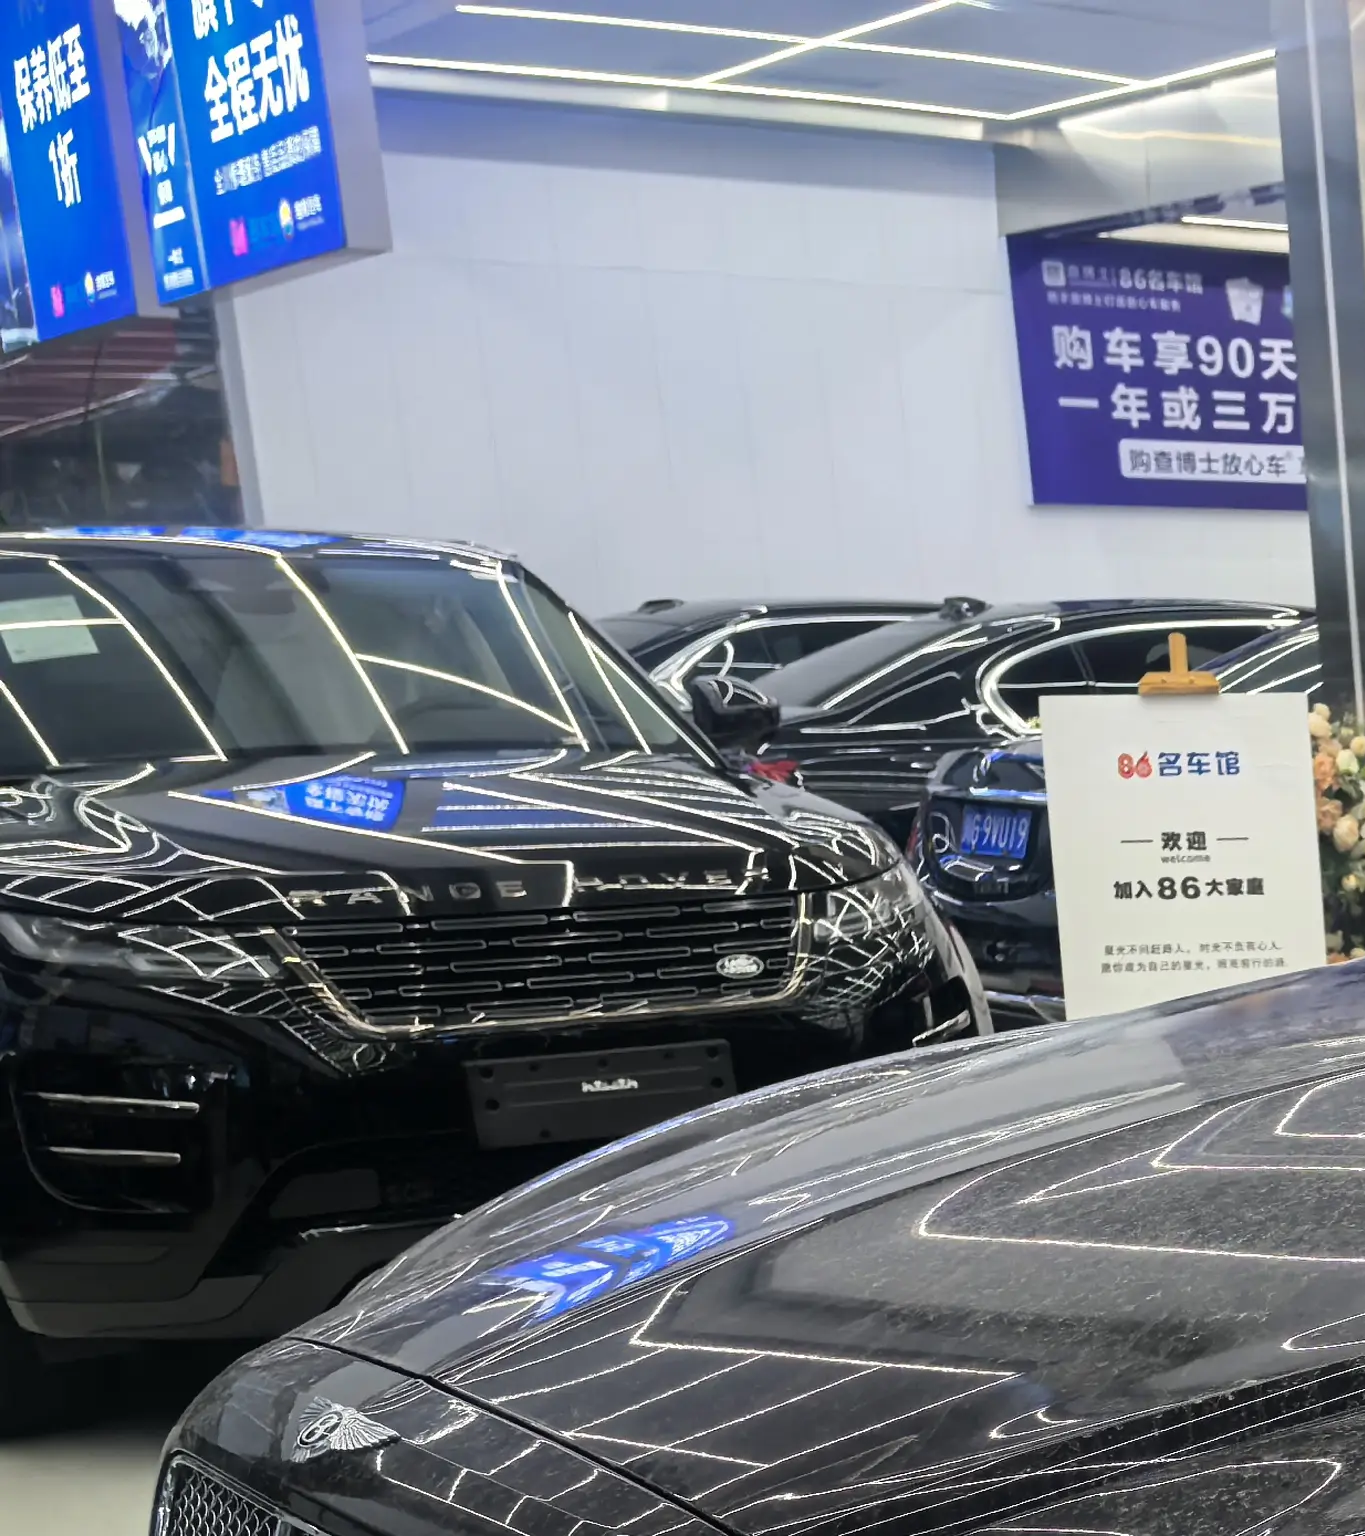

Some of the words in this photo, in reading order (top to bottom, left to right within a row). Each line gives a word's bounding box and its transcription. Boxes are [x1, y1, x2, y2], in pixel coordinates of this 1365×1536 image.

[13, 24, 91, 134] 保养低至
[204, 14, 310, 144] 全程无忧
[48, 128, 82, 208] 1折
[1052, 325, 1298, 381] 购车享90天
[1058, 382, 1297, 434] 一年或三万
[1118, 751, 1240, 779] 86名车馆
[1161, 831, 1207, 851] 欢迎
[1161, 855, 1211, 863] welcome
[1114, 876, 1265, 900] 加入86大家庭
